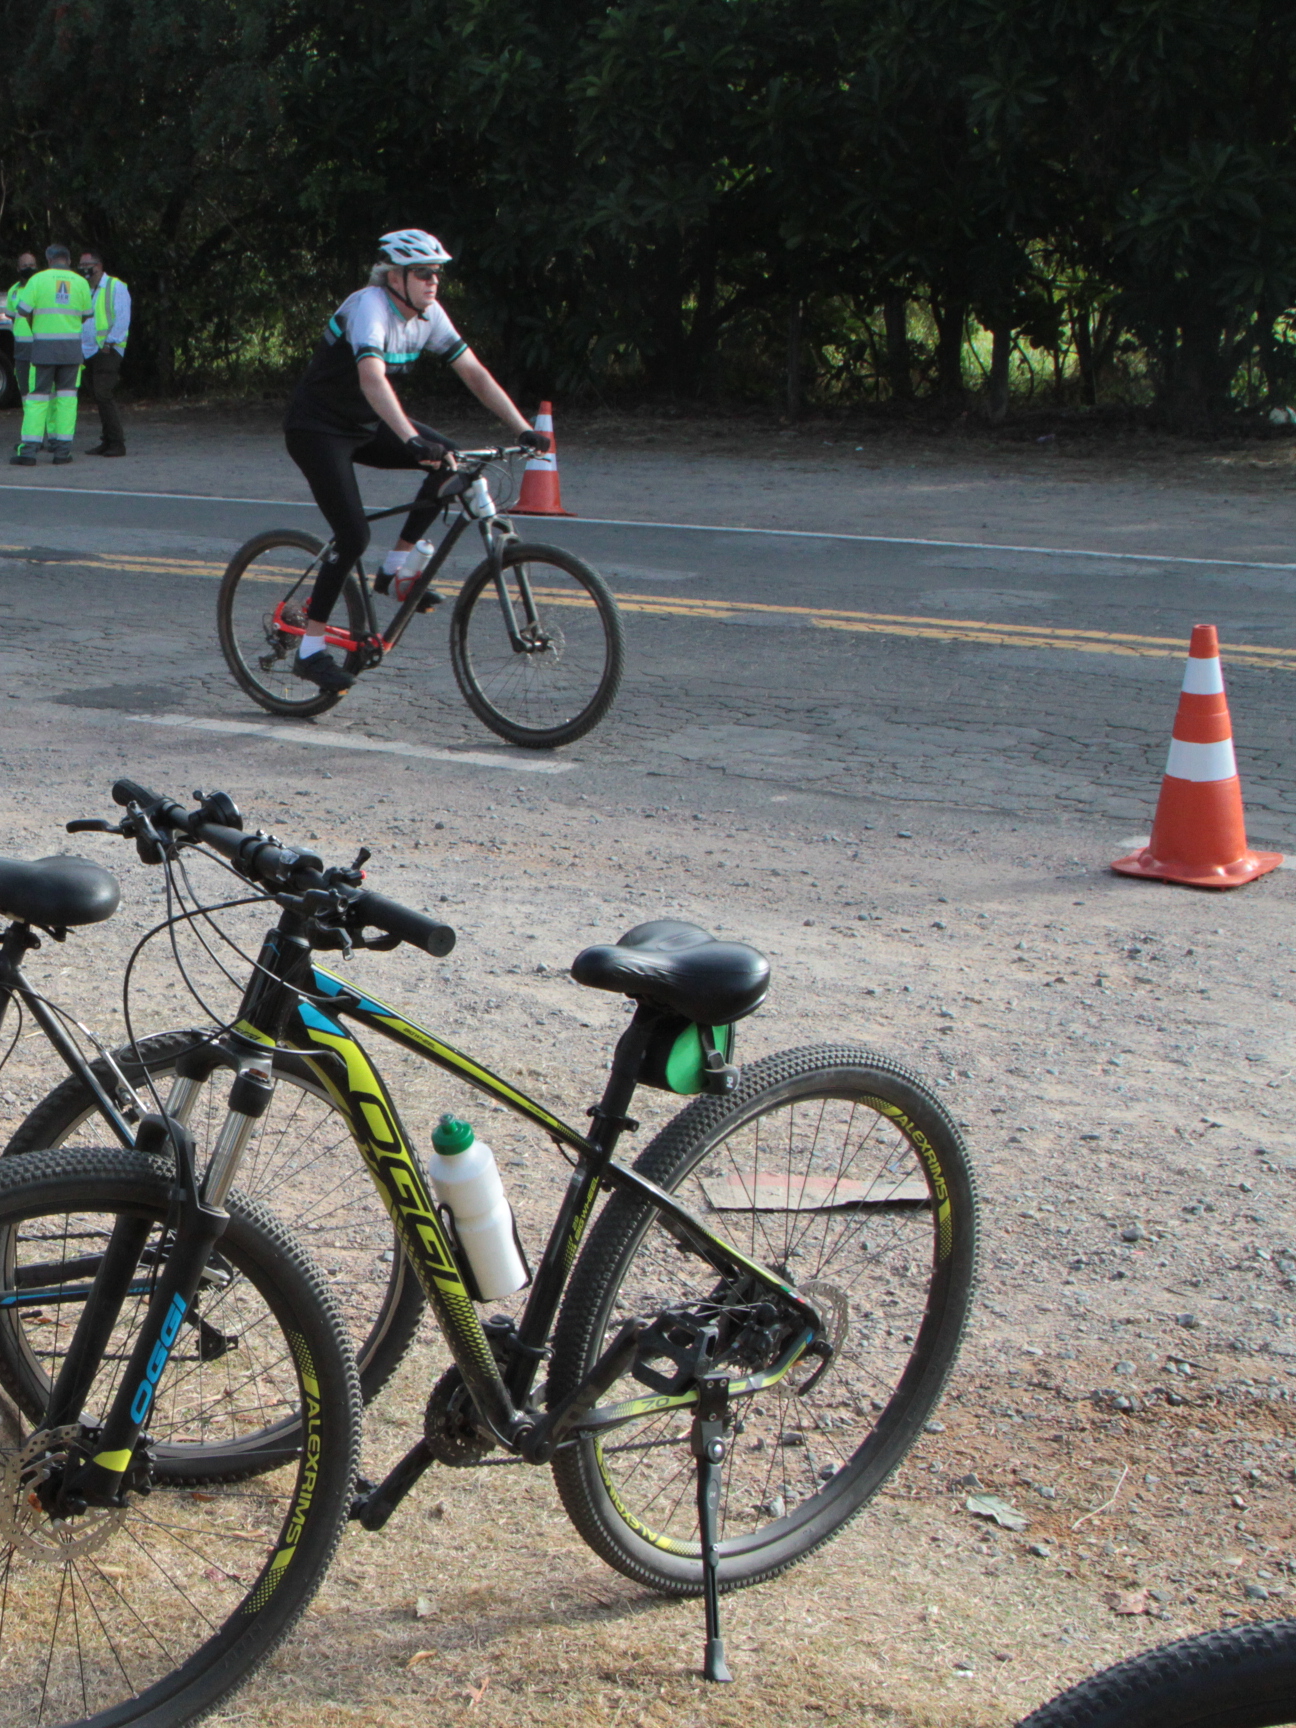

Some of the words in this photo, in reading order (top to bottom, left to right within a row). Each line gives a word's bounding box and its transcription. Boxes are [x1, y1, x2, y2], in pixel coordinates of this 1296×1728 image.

[349, 1090, 462, 1284] OGGI
[893, 1115, 949, 1200] ALEXRIMS
[130, 1291, 187, 1424] OGGI
[641, 1397, 671, 1411] 7.0
[285, 1396, 321, 1545] ALEXRIMS
